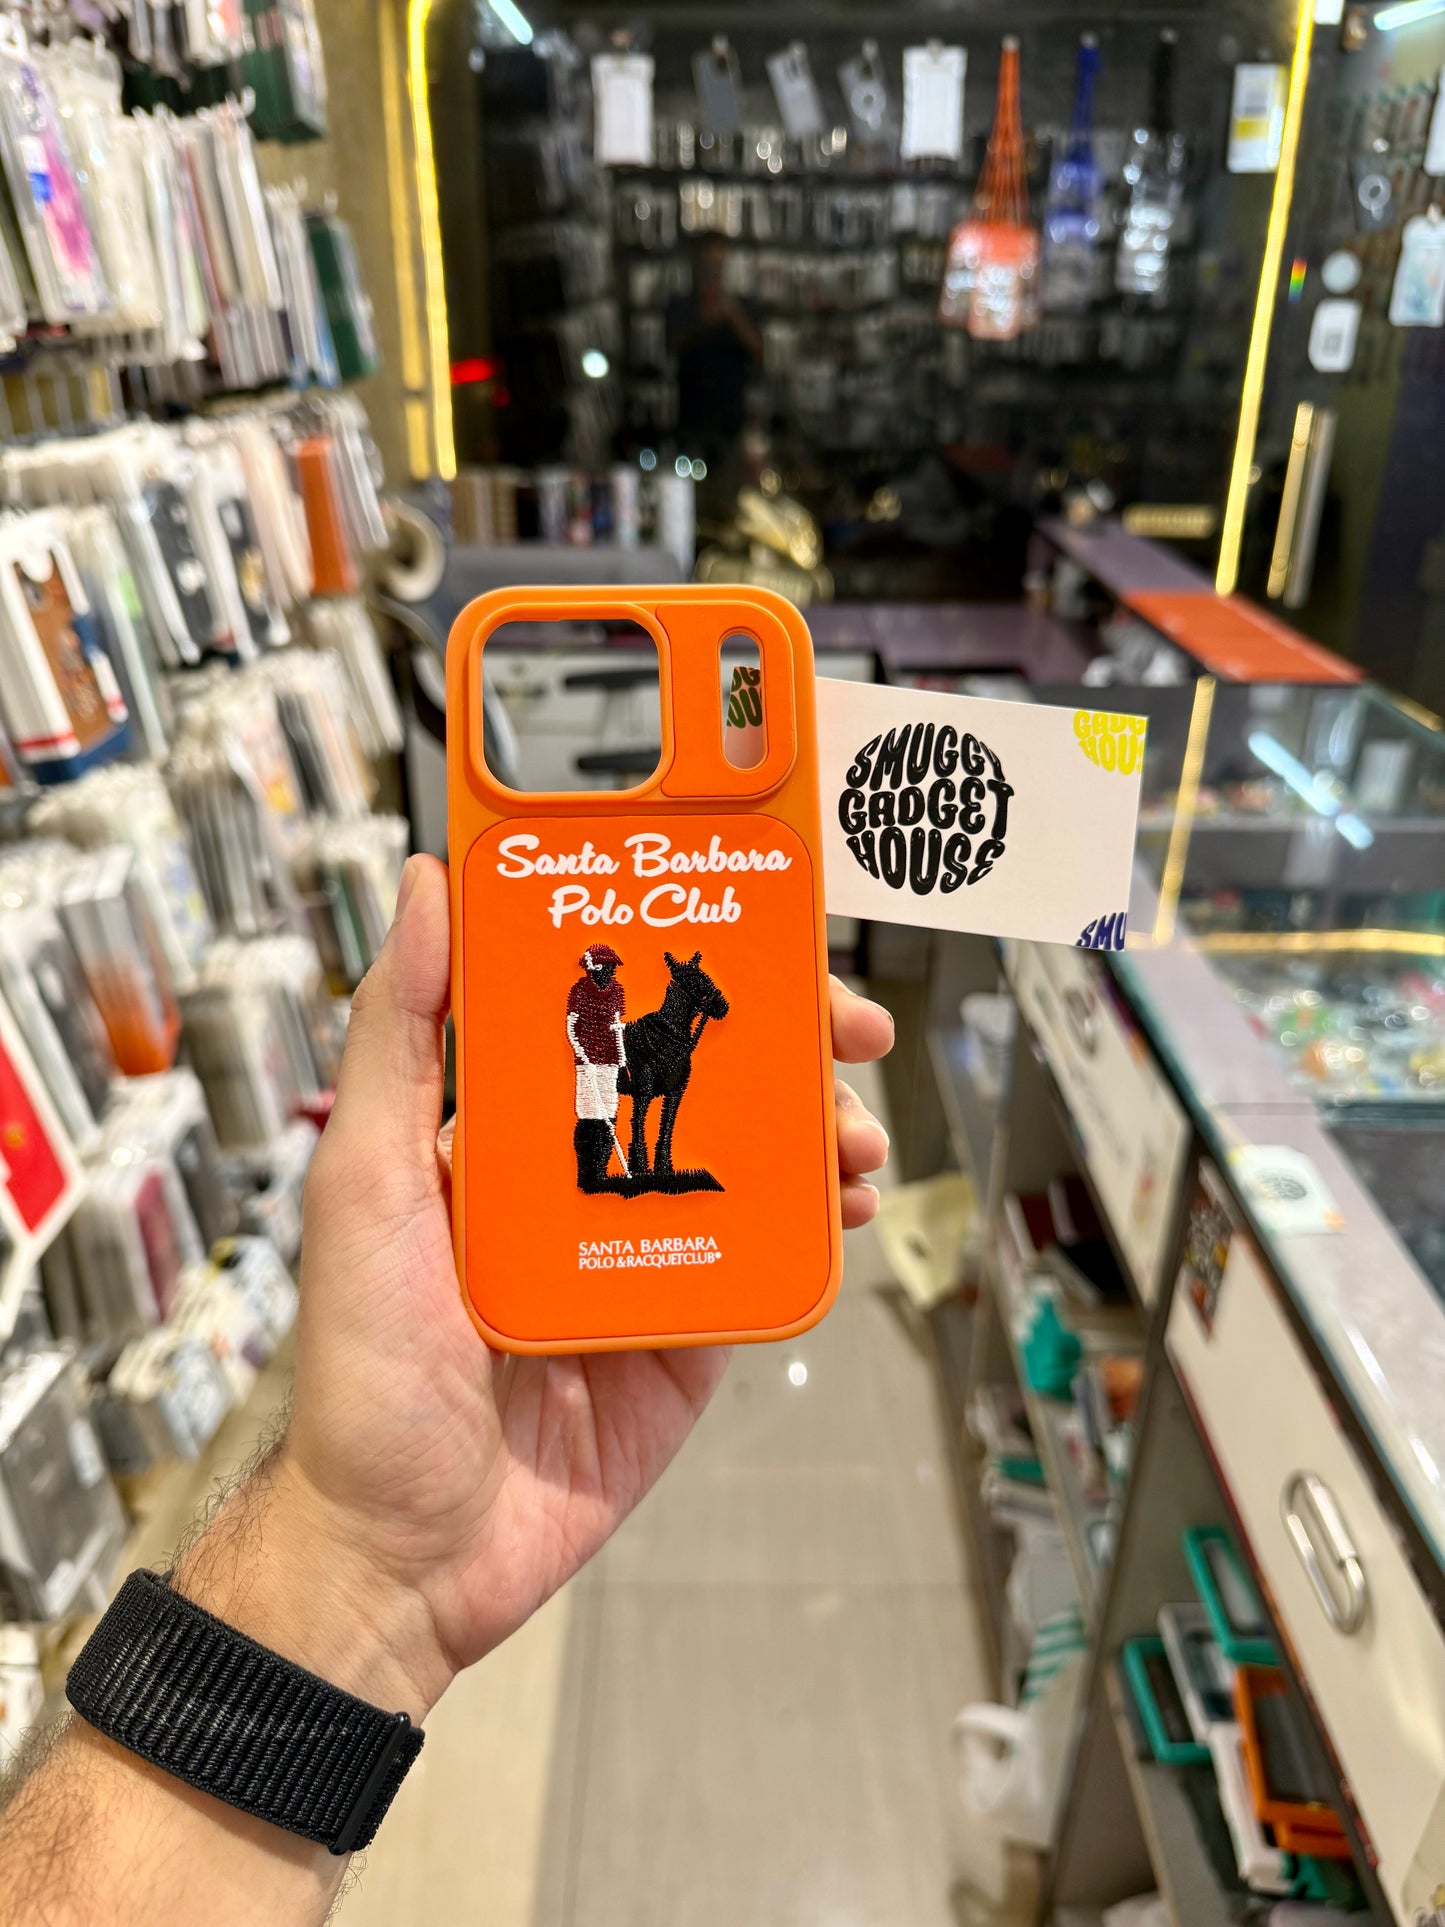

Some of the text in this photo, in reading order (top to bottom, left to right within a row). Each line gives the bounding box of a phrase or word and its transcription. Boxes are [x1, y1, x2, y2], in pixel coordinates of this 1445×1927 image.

[846, 723, 1005, 791] SMUGGY
[839, 777, 1014, 840] GADGET
[497, 832, 793, 879] Santa Barbara
[846, 826, 1006, 895] HOUSE
[547, 882, 742, 929] Polo Club
[578, 1236, 718, 1257] SANTA BARBARA
[578, 1256, 615, 1270] POLO
